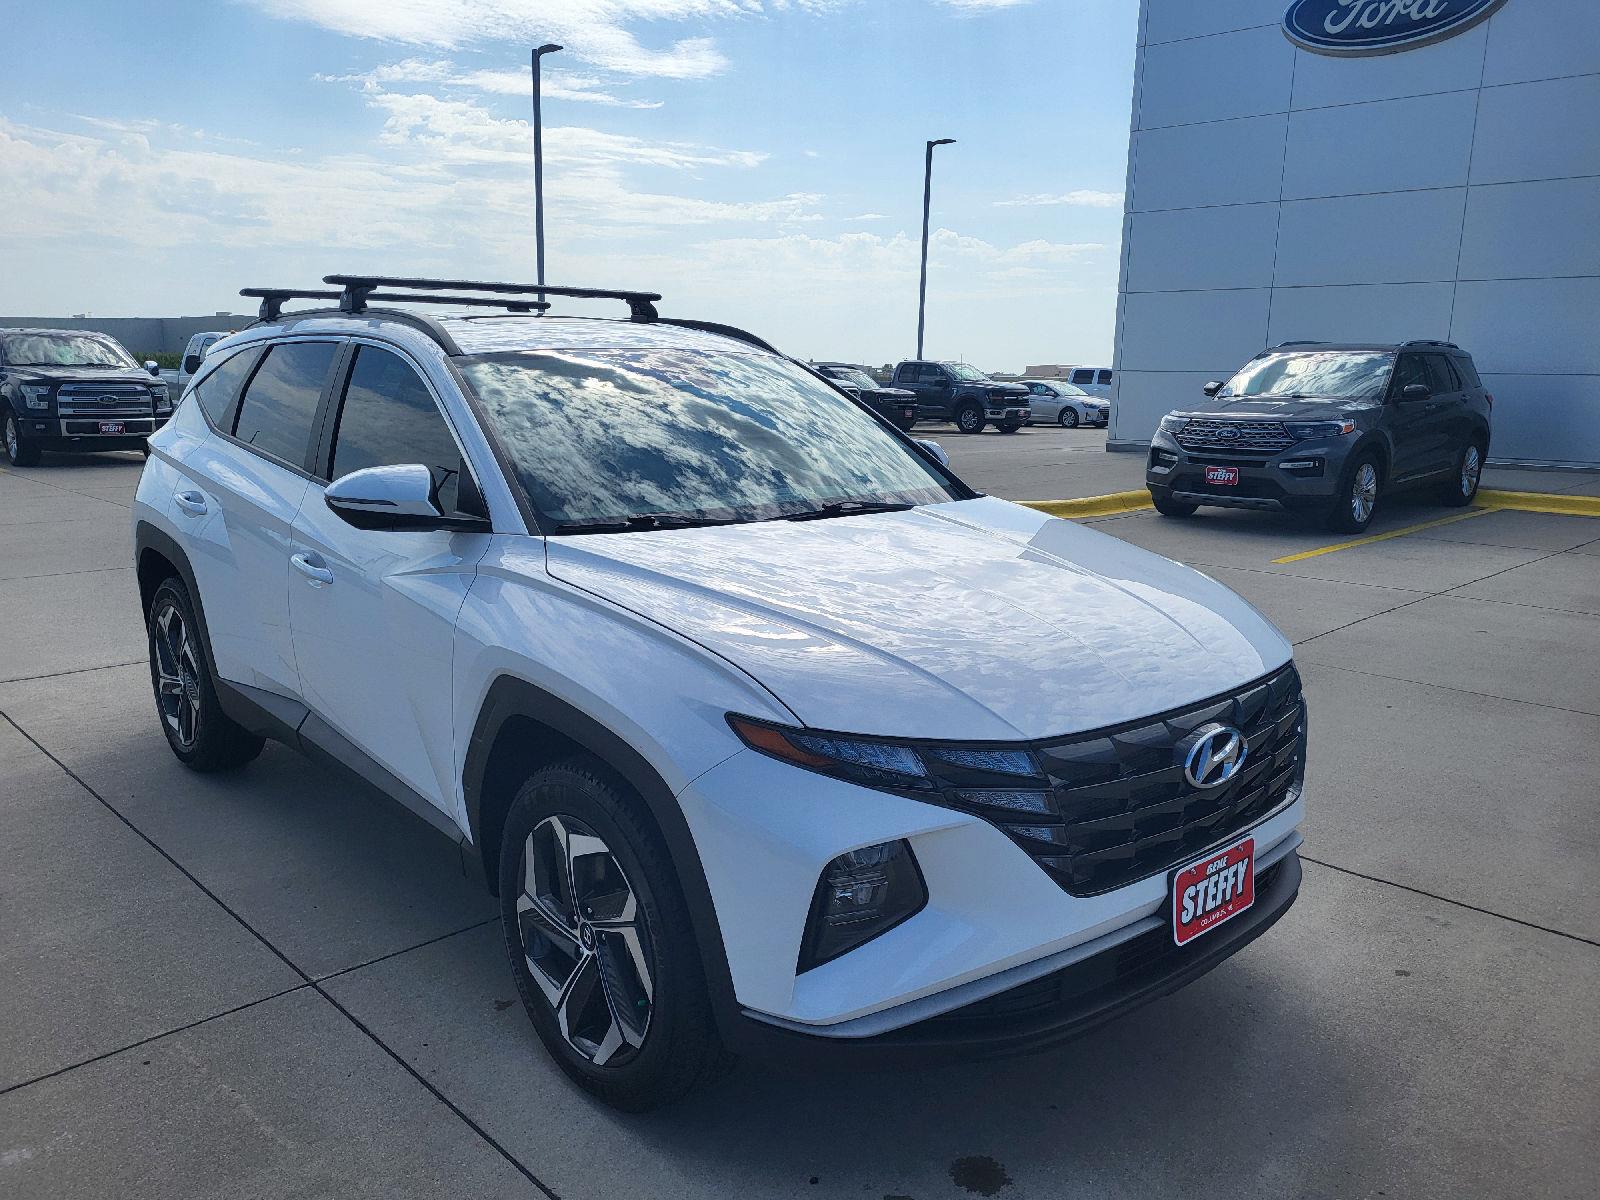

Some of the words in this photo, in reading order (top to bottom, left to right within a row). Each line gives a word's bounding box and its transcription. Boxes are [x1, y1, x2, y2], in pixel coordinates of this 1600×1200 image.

[1208, 471, 1235, 481] STEFFY
[1206, 855, 1229, 875] GENE
[1181, 857, 1249, 924] STEFFY
